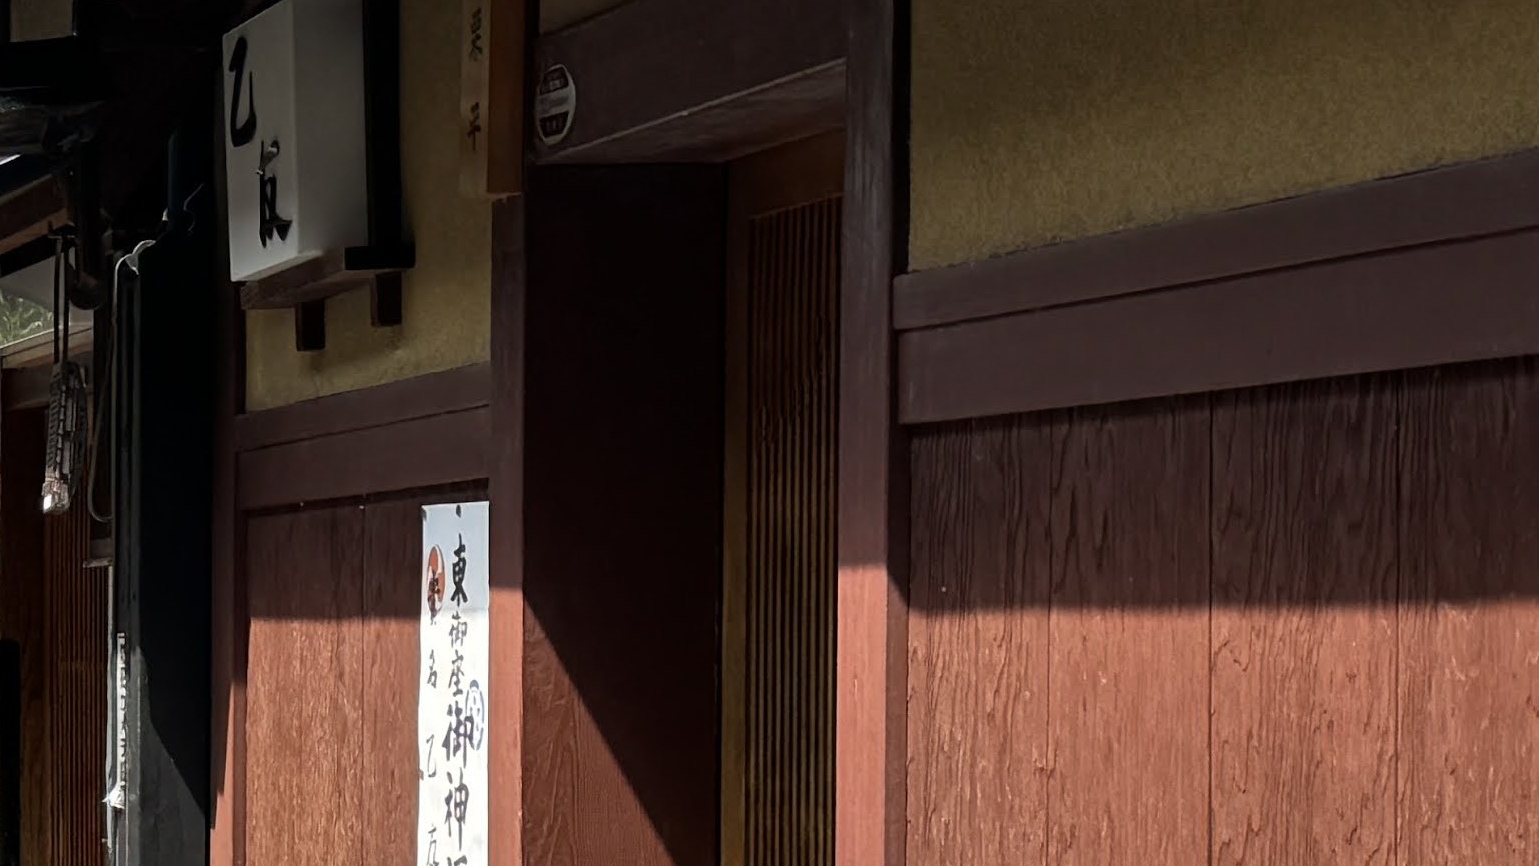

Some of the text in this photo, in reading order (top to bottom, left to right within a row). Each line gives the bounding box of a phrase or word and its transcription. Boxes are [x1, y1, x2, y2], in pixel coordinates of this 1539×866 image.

[442, 533, 475, 866] 東御座御神
